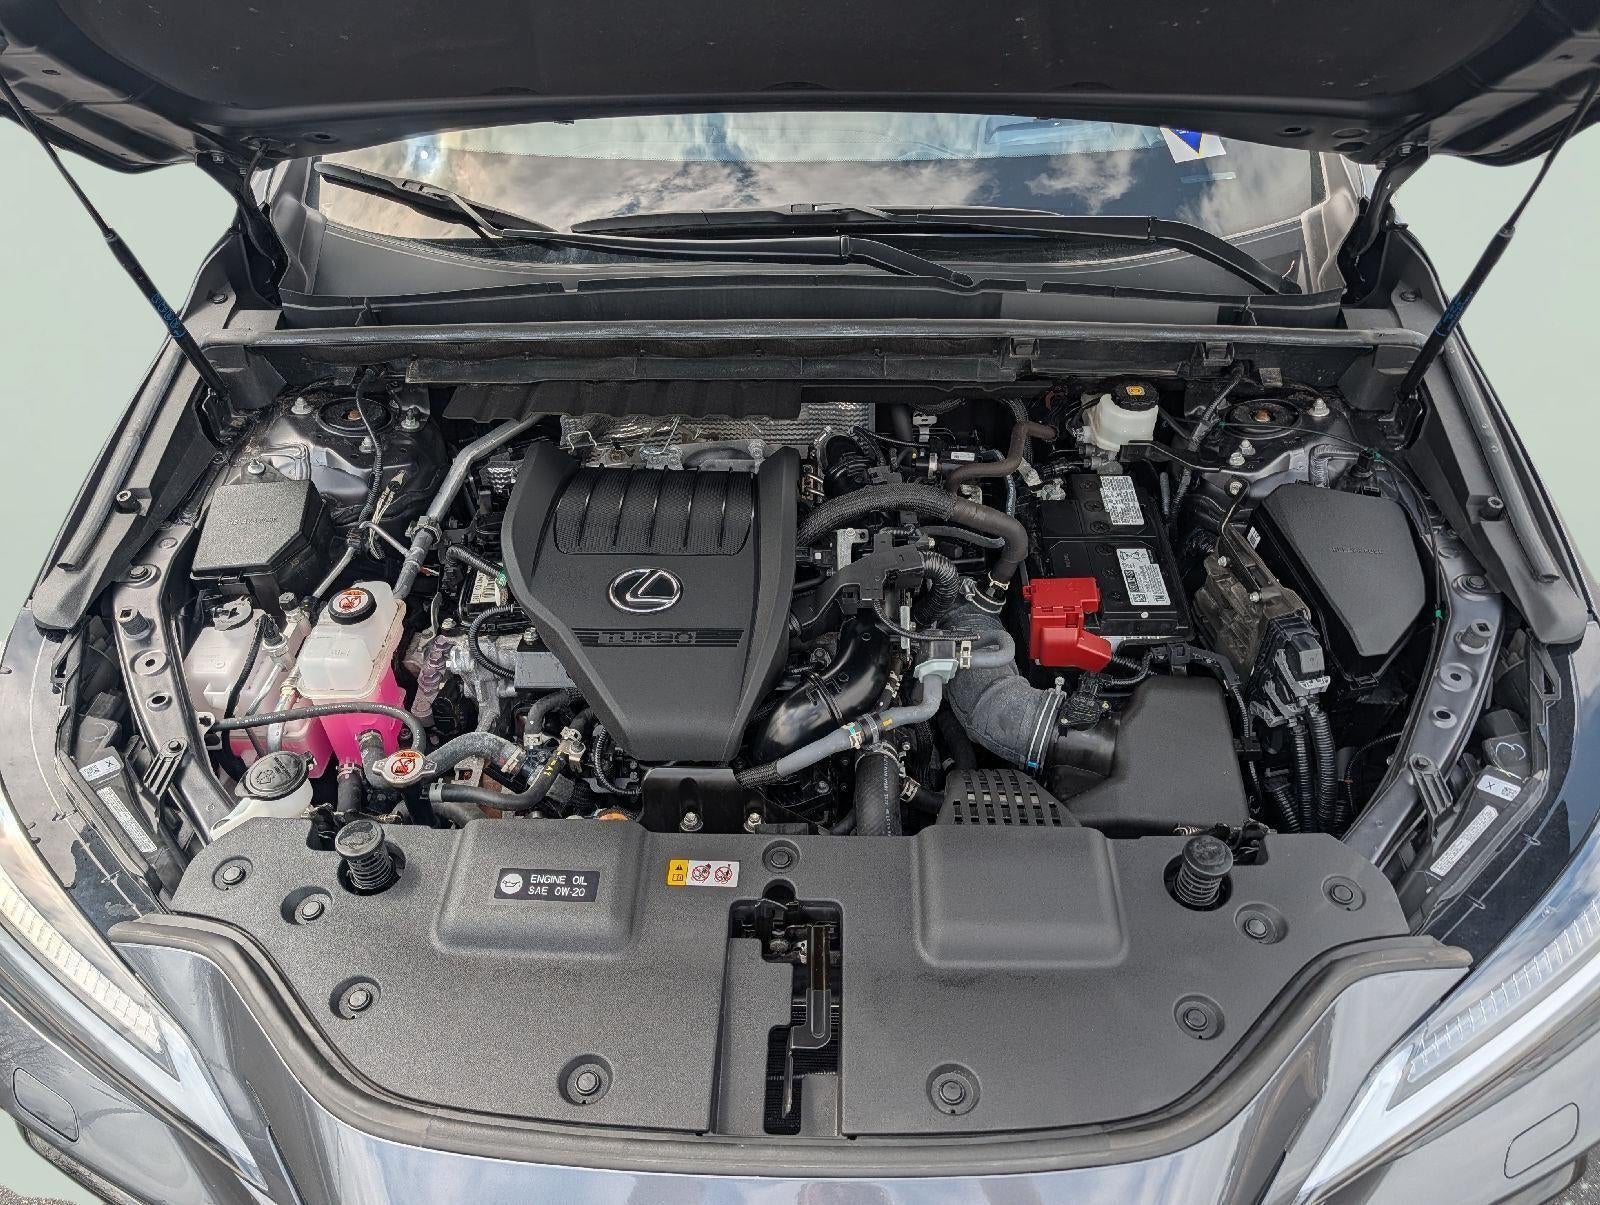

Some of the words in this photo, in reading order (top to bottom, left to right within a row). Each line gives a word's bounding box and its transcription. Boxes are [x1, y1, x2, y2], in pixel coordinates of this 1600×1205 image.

[600, 631, 697, 645] TURBO
[530, 874, 566, 885] ENGINE
[572, 875, 588, 886] OIL
[528, 885, 549, 896] SAE
[554, 886, 586, 897] 0W-20
